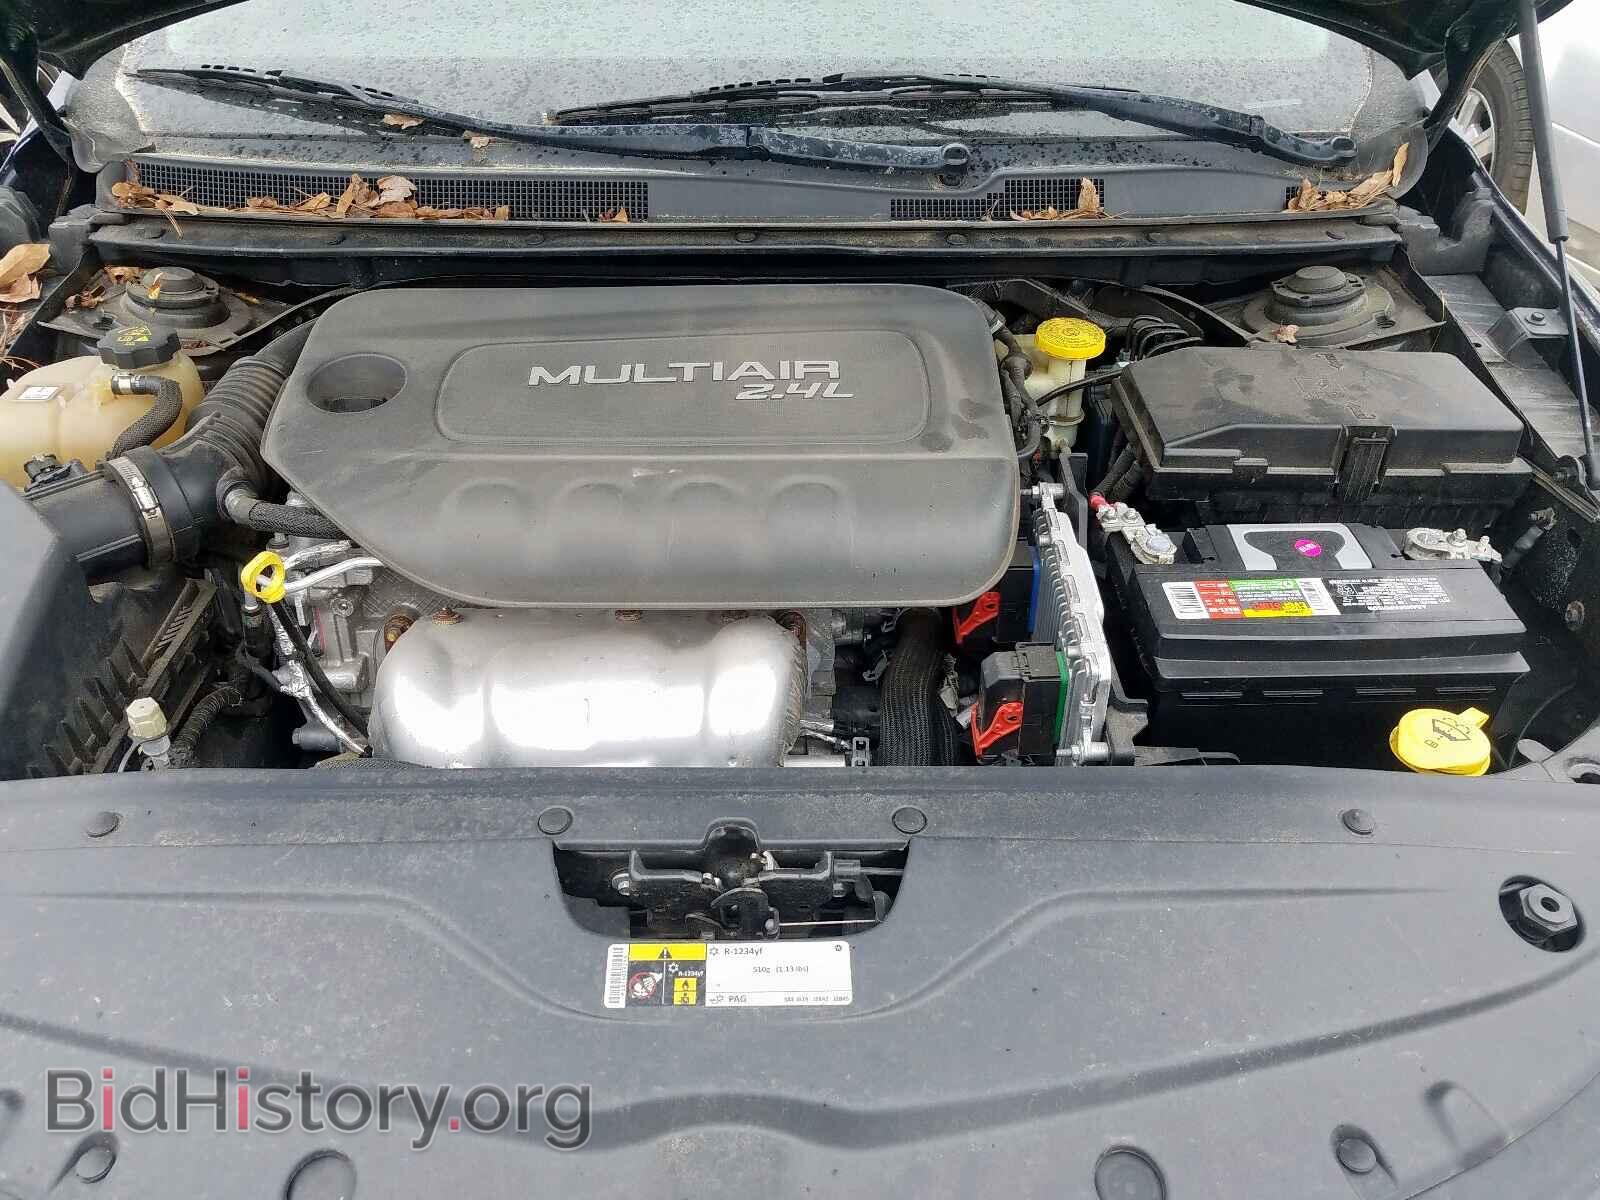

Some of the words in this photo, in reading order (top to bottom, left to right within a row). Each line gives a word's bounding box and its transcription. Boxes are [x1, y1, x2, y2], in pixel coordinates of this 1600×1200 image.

[528, 360, 840, 386] MULTIAIR
[735, 382, 854, 400] 2.4L
[724, 947, 763, 957] R-1234yf
[728, 995, 748, 1003] PAG
